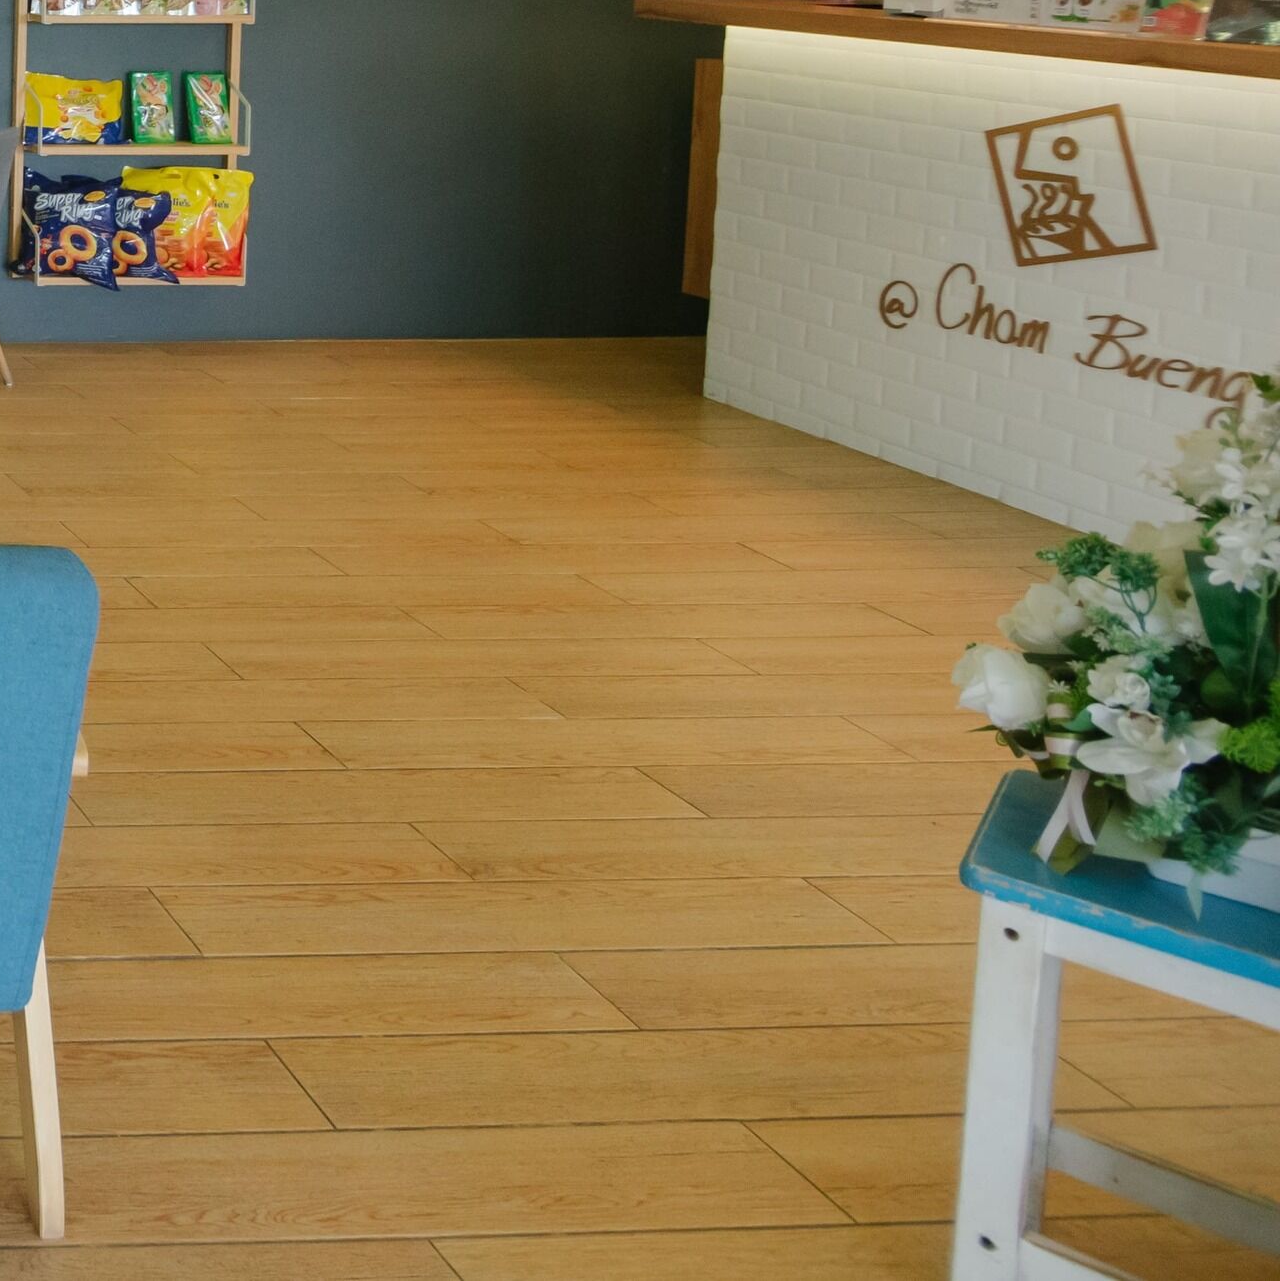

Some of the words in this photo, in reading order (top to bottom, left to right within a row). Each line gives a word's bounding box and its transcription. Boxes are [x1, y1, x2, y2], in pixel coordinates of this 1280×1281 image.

[34, 192, 82, 211] Super
[59, 203, 96, 223] Ring
[878, 280, 920, 330] @
[935, 262, 1050, 354] Cham
[1074, 313, 1249, 429] Bueng
